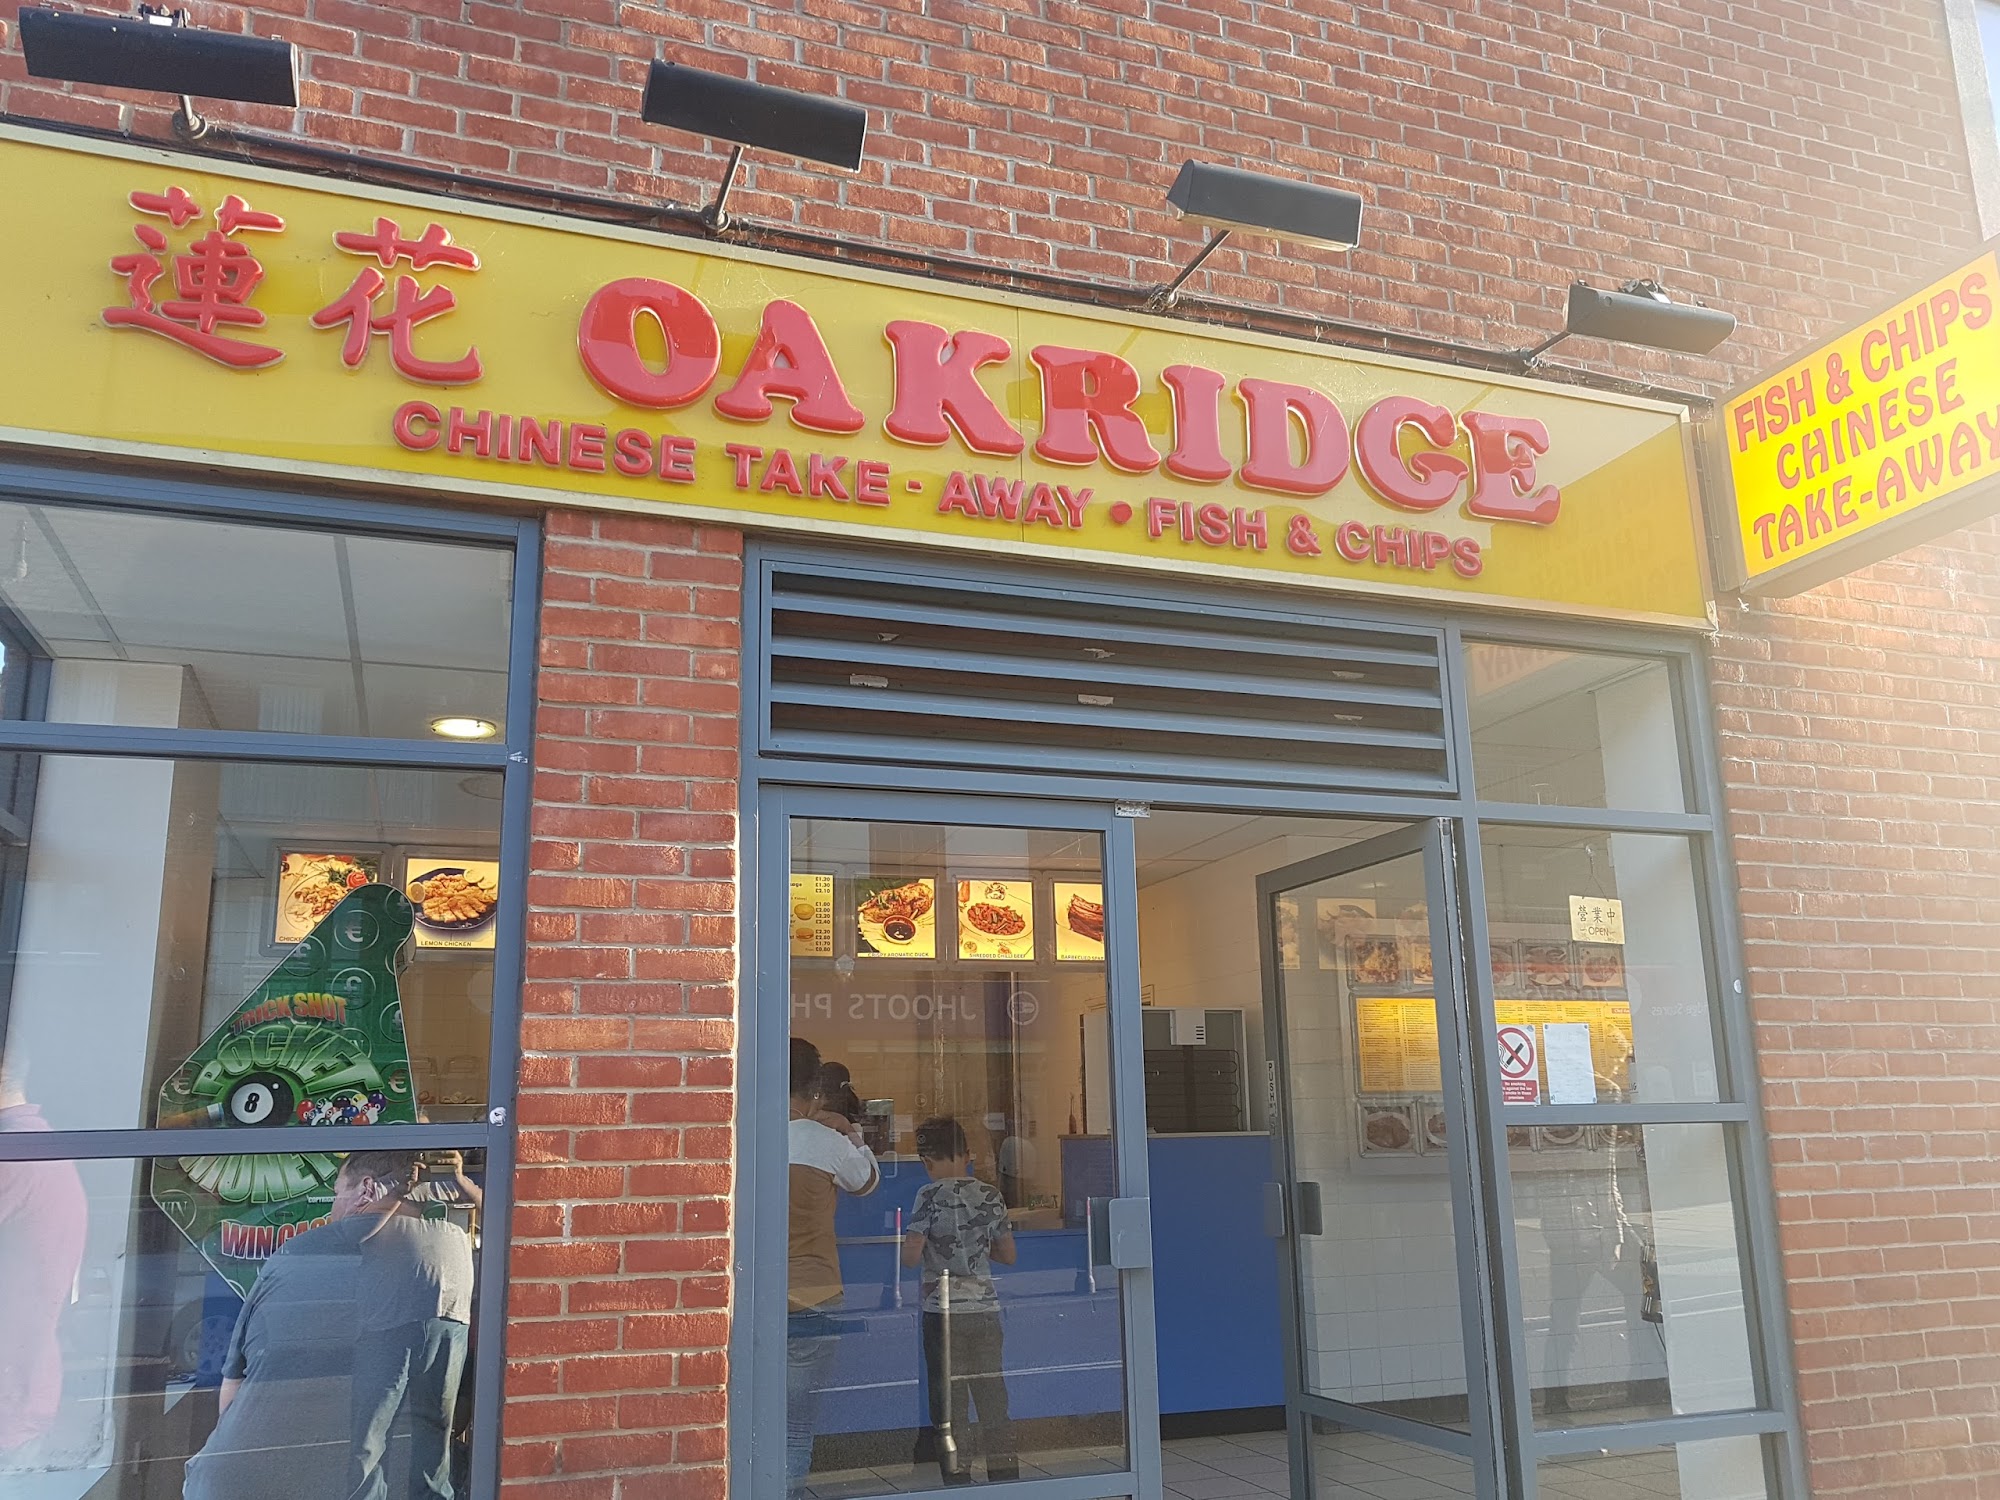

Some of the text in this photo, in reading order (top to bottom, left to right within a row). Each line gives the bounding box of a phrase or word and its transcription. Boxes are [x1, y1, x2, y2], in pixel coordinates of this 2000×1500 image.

[103, 186, 484, 385] 蓮花
[578, 276, 1562, 527] OAKRIDGE
[1734, 272, 1993, 452] FISH & CHIPS
[1776, 358, 1966, 490] CHINESE
[392, 400, 697, 483] CHINESE
[724, 442, 892, 506] TAKE
[937, 472, 1094, 529] AWAY
[1148, 496, 1268, 551] FISH
[1287, 514, 1323, 555] &
[1335, 519, 1483, 578] CHIPS
[1753, 405, 2000, 560] TAKE-AWAY
[1577, 904, 1616, 925] 營業中
[1588, 926, 1609, 936] OPEN
[191, 1024, 385, 1097] POCKET
[230, 995, 293, 1036] TRICK
[292, 992, 348, 1025] SHOT
[221, 1219, 274, 1260] WIN
